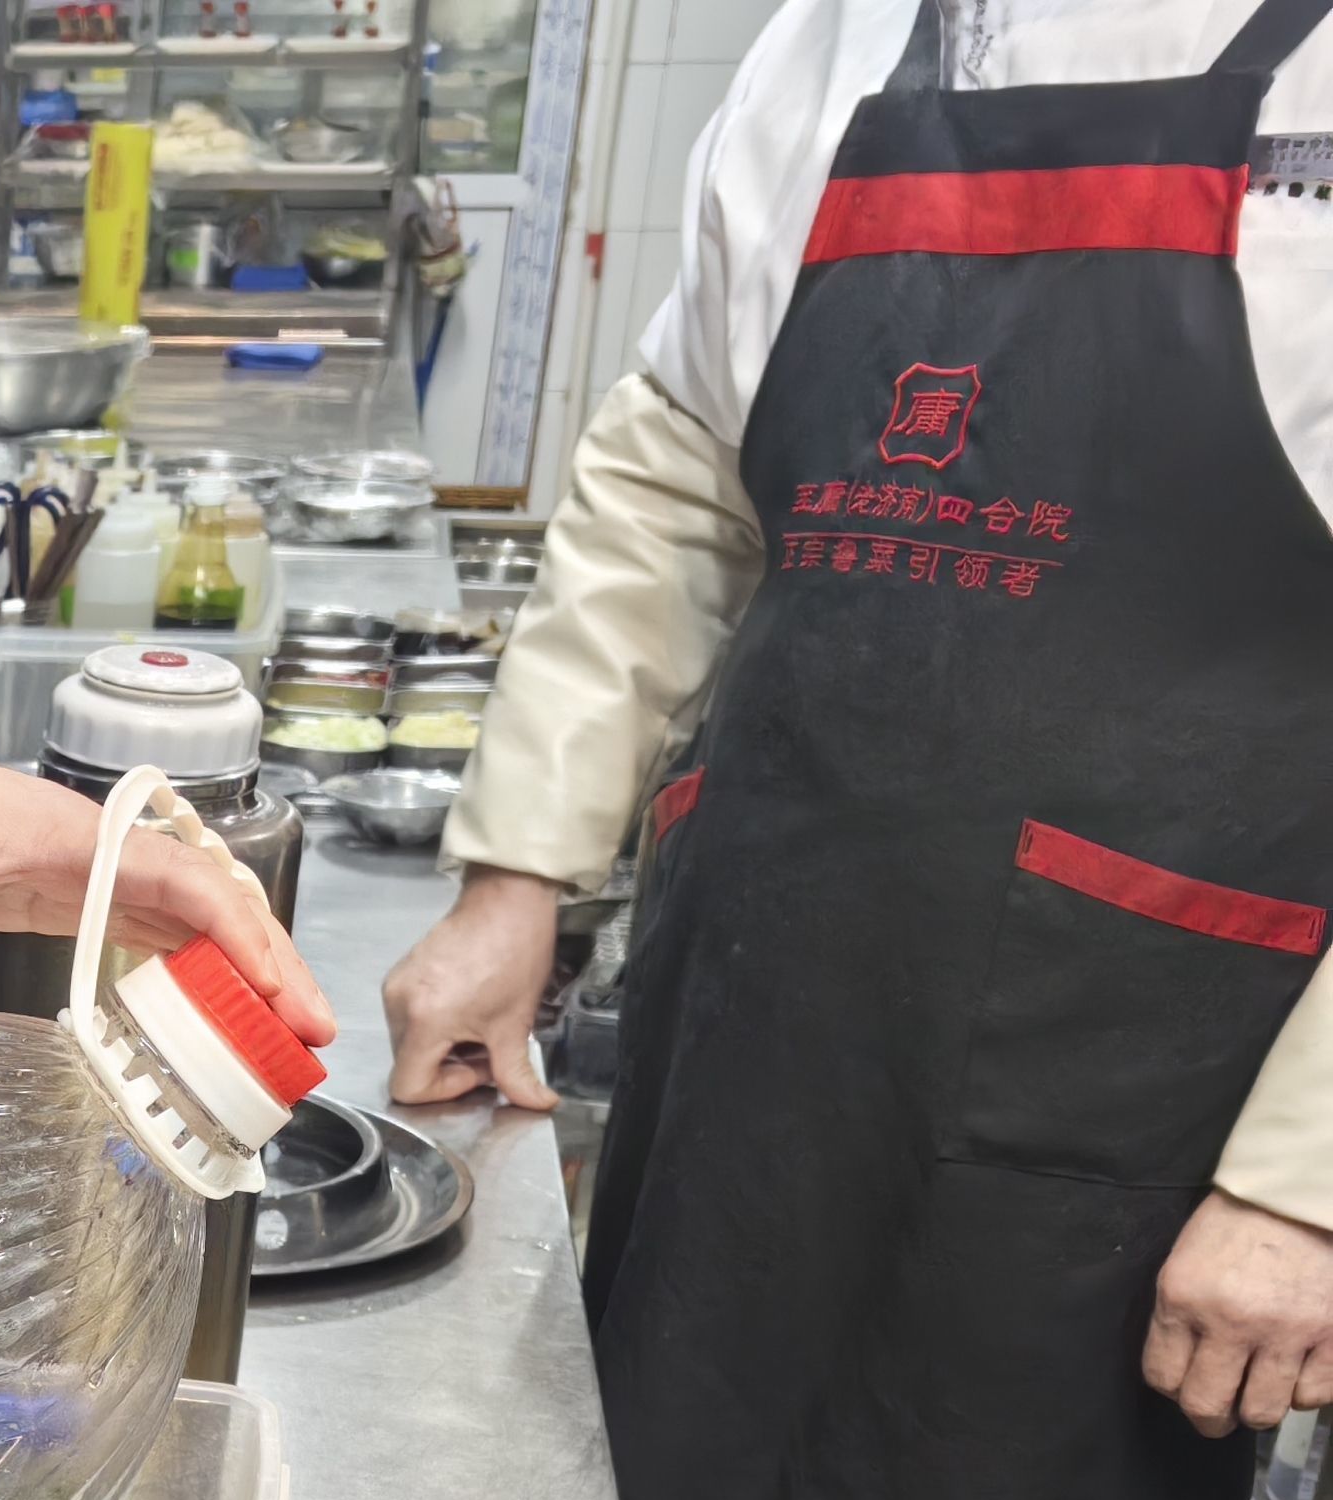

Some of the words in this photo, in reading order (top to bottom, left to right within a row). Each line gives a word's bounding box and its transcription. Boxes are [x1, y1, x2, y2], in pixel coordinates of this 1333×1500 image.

[780, 537, 1042, 598] 正宗鲁菜引领者
